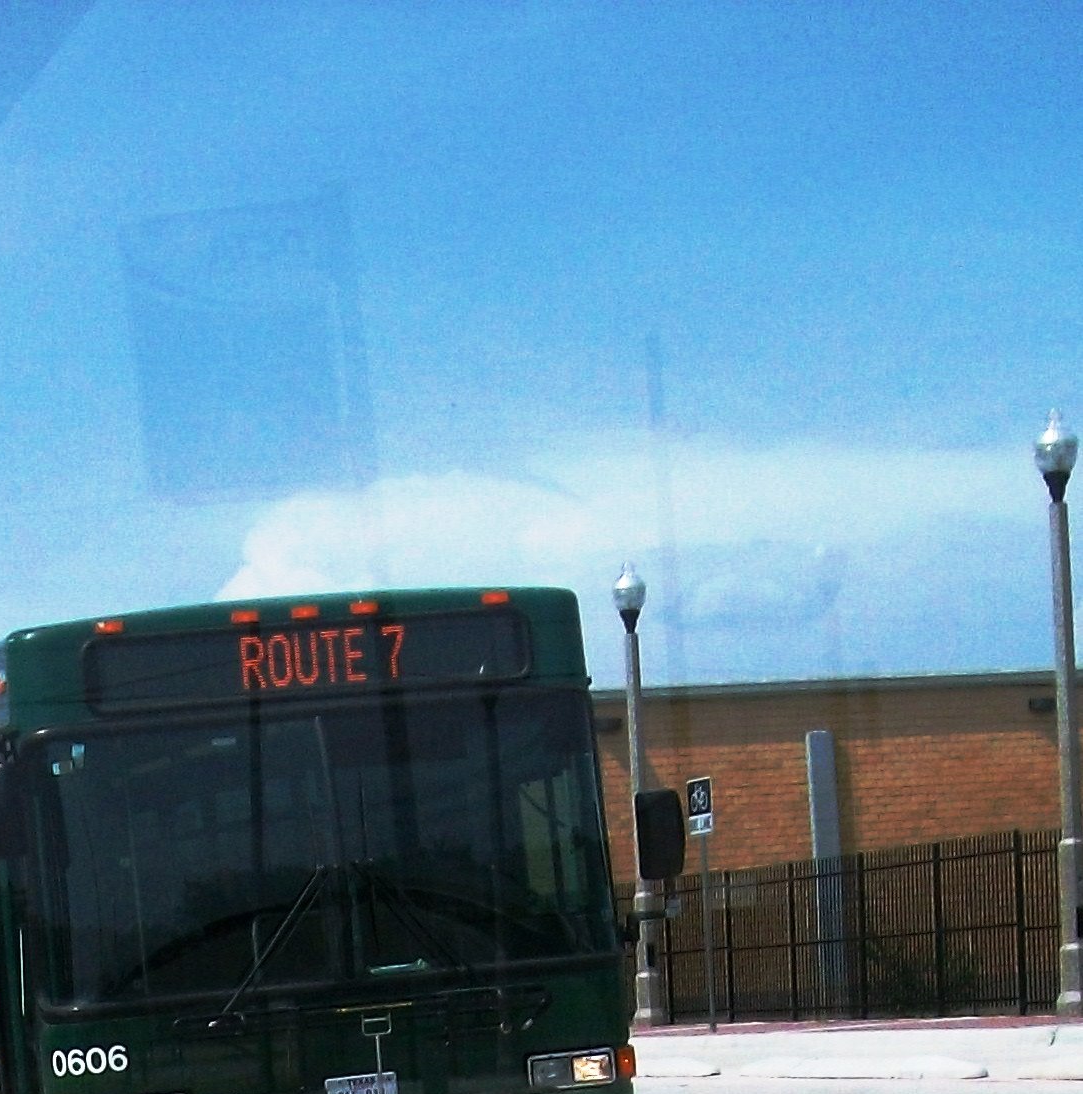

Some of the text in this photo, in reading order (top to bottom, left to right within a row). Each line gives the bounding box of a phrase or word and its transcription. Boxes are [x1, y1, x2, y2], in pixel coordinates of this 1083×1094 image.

[240, 625, 405, 689] ROUTE 7
[52, 1044, 129, 1077] 0606
